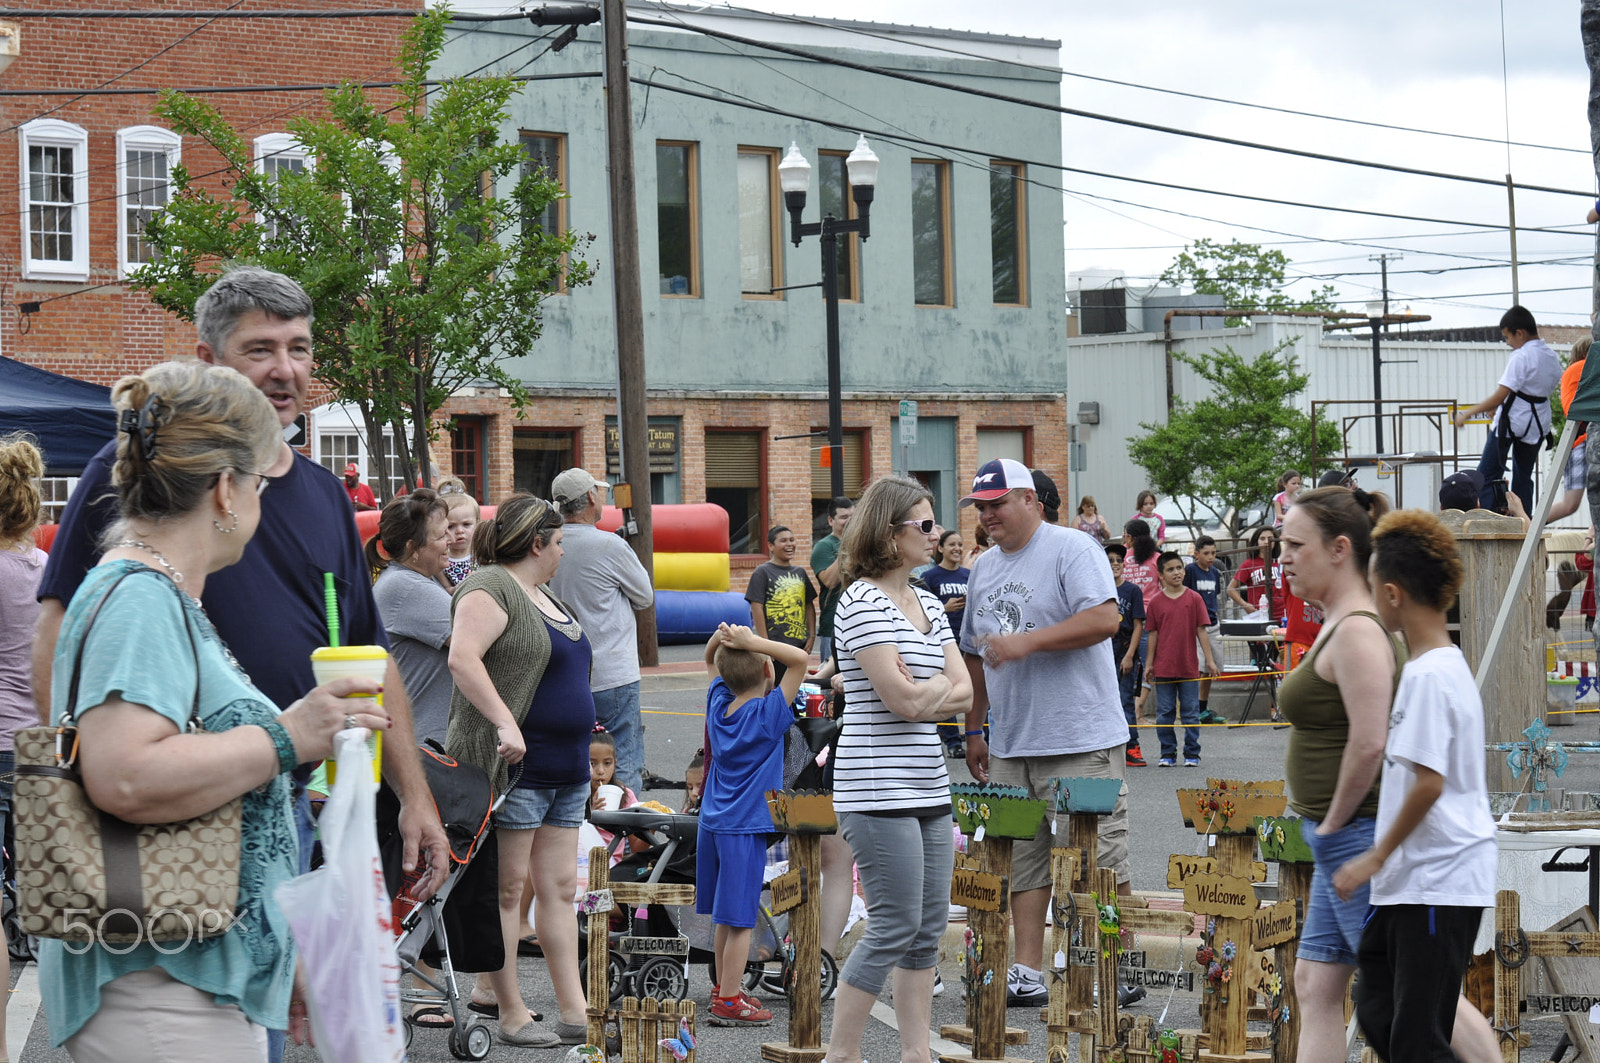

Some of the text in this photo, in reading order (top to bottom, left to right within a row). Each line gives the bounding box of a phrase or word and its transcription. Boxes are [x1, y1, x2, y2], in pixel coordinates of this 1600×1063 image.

[648, 428, 675, 441] Tatum
[658, 441, 671, 449] LAW
[940, 582, 968, 596] ASTRO
[987, 586, 1002, 603] Bill
[772, 879, 799, 905] Welcome
[955, 875, 996, 902] Welcome
[1196, 883, 1247, 906] Welcome
[1255, 911, 1293, 940] Welcome
[623, 938, 683, 952] WELCOME
[1125, 970, 1184, 989] WELCOME
